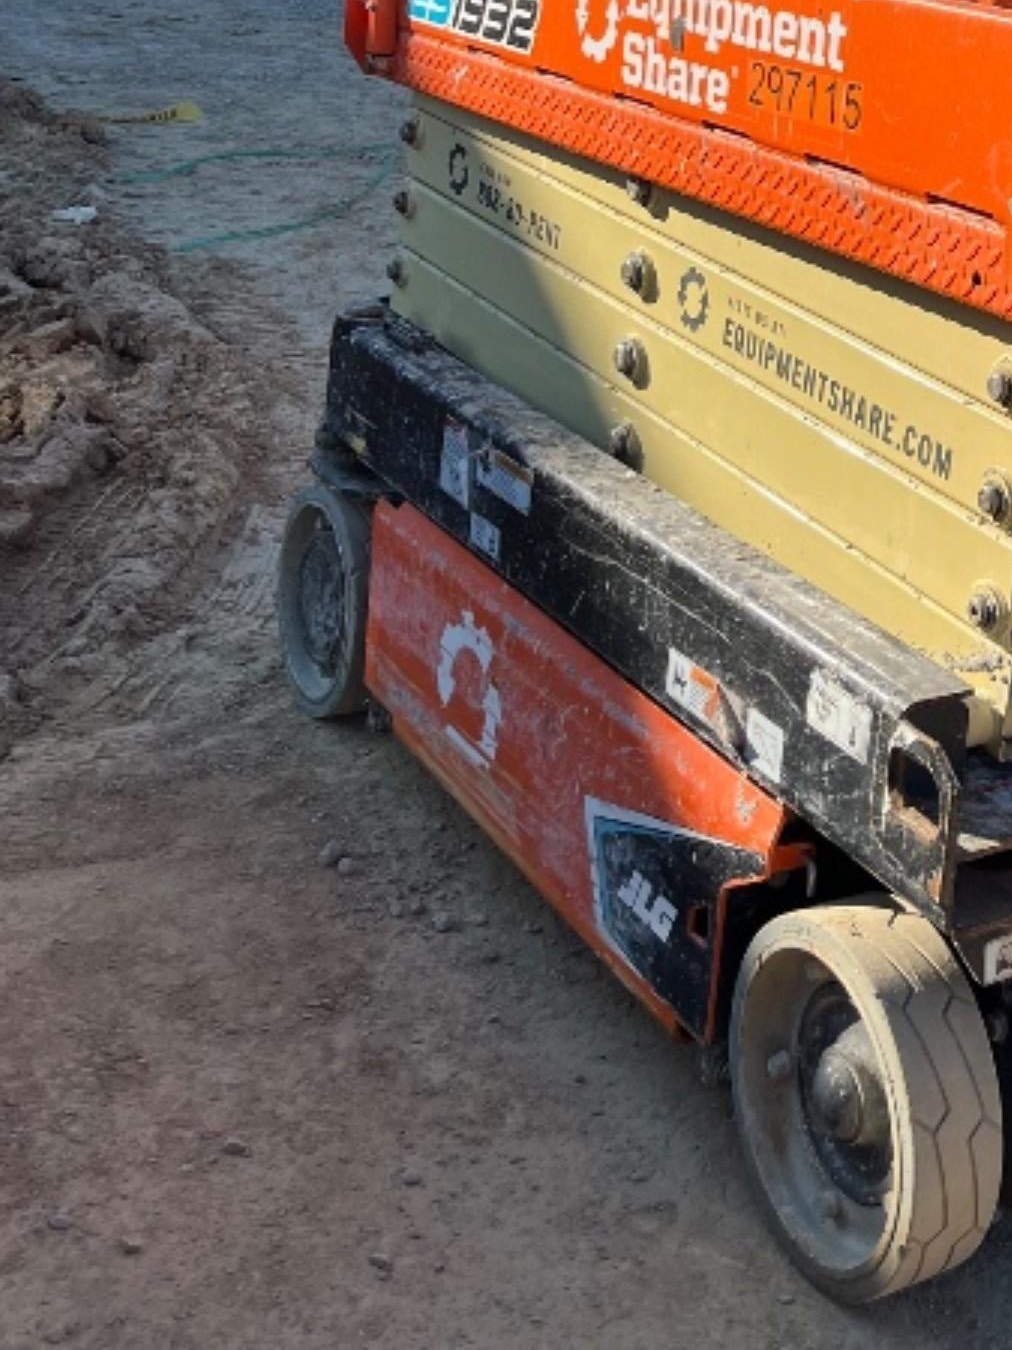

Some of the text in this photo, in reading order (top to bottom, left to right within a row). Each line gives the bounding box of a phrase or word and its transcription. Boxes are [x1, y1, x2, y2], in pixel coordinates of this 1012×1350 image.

[622, 31, 730, 114] Share
[749, 62, 862, 130] 297115
[723, 318, 953, 480] EQUIPMENTSHARE.COM
[617, 870, 678, 943] JLG
